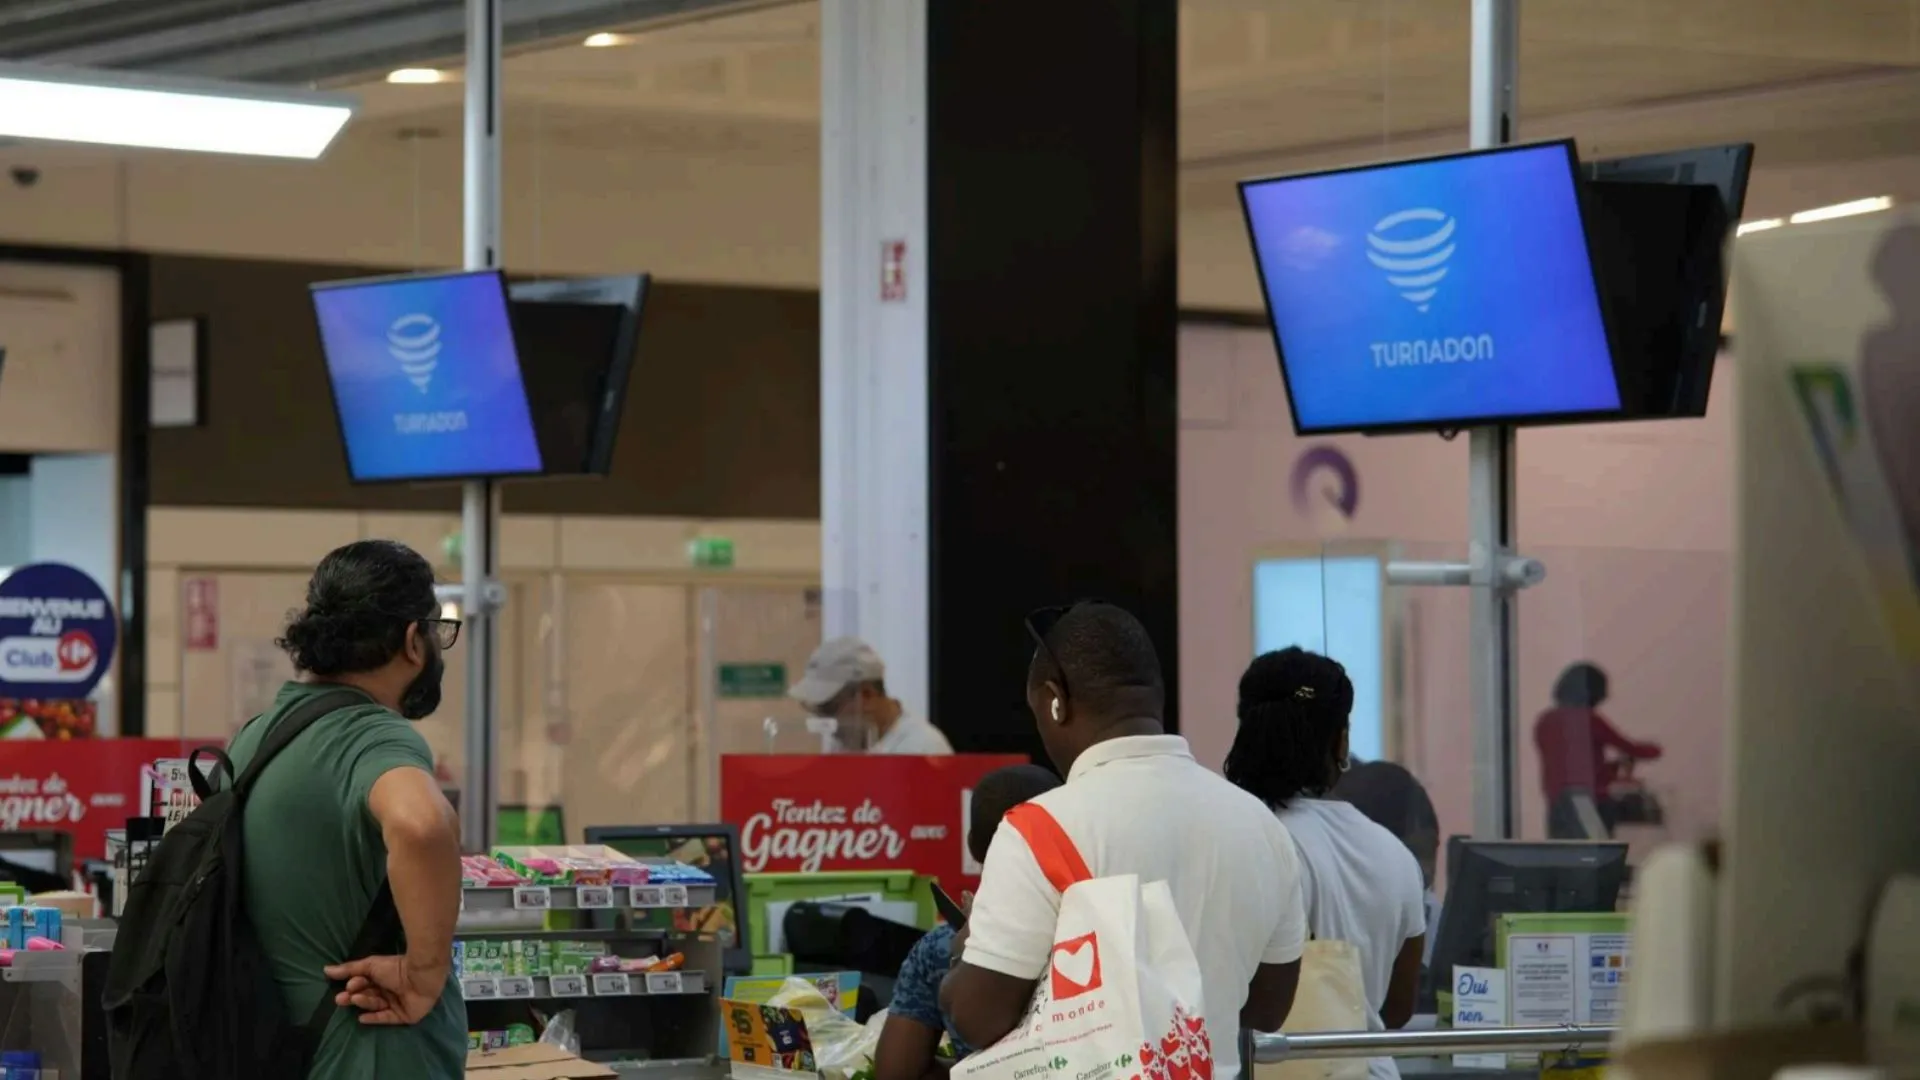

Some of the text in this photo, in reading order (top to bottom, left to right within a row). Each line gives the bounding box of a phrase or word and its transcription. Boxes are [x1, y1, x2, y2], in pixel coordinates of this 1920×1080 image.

[1370, 333, 1494, 368] TURNADON
[0, 597, 105, 619] IENVENUE
[30, 616, 63, 636] AU
[6, 648, 54, 668] Club
[772, 798, 882, 824] Tentez de
[741, 813, 905, 873] Gagner
[1457, 972, 1489, 997] Oui
[1052, 1000, 1105, 1022] monde
